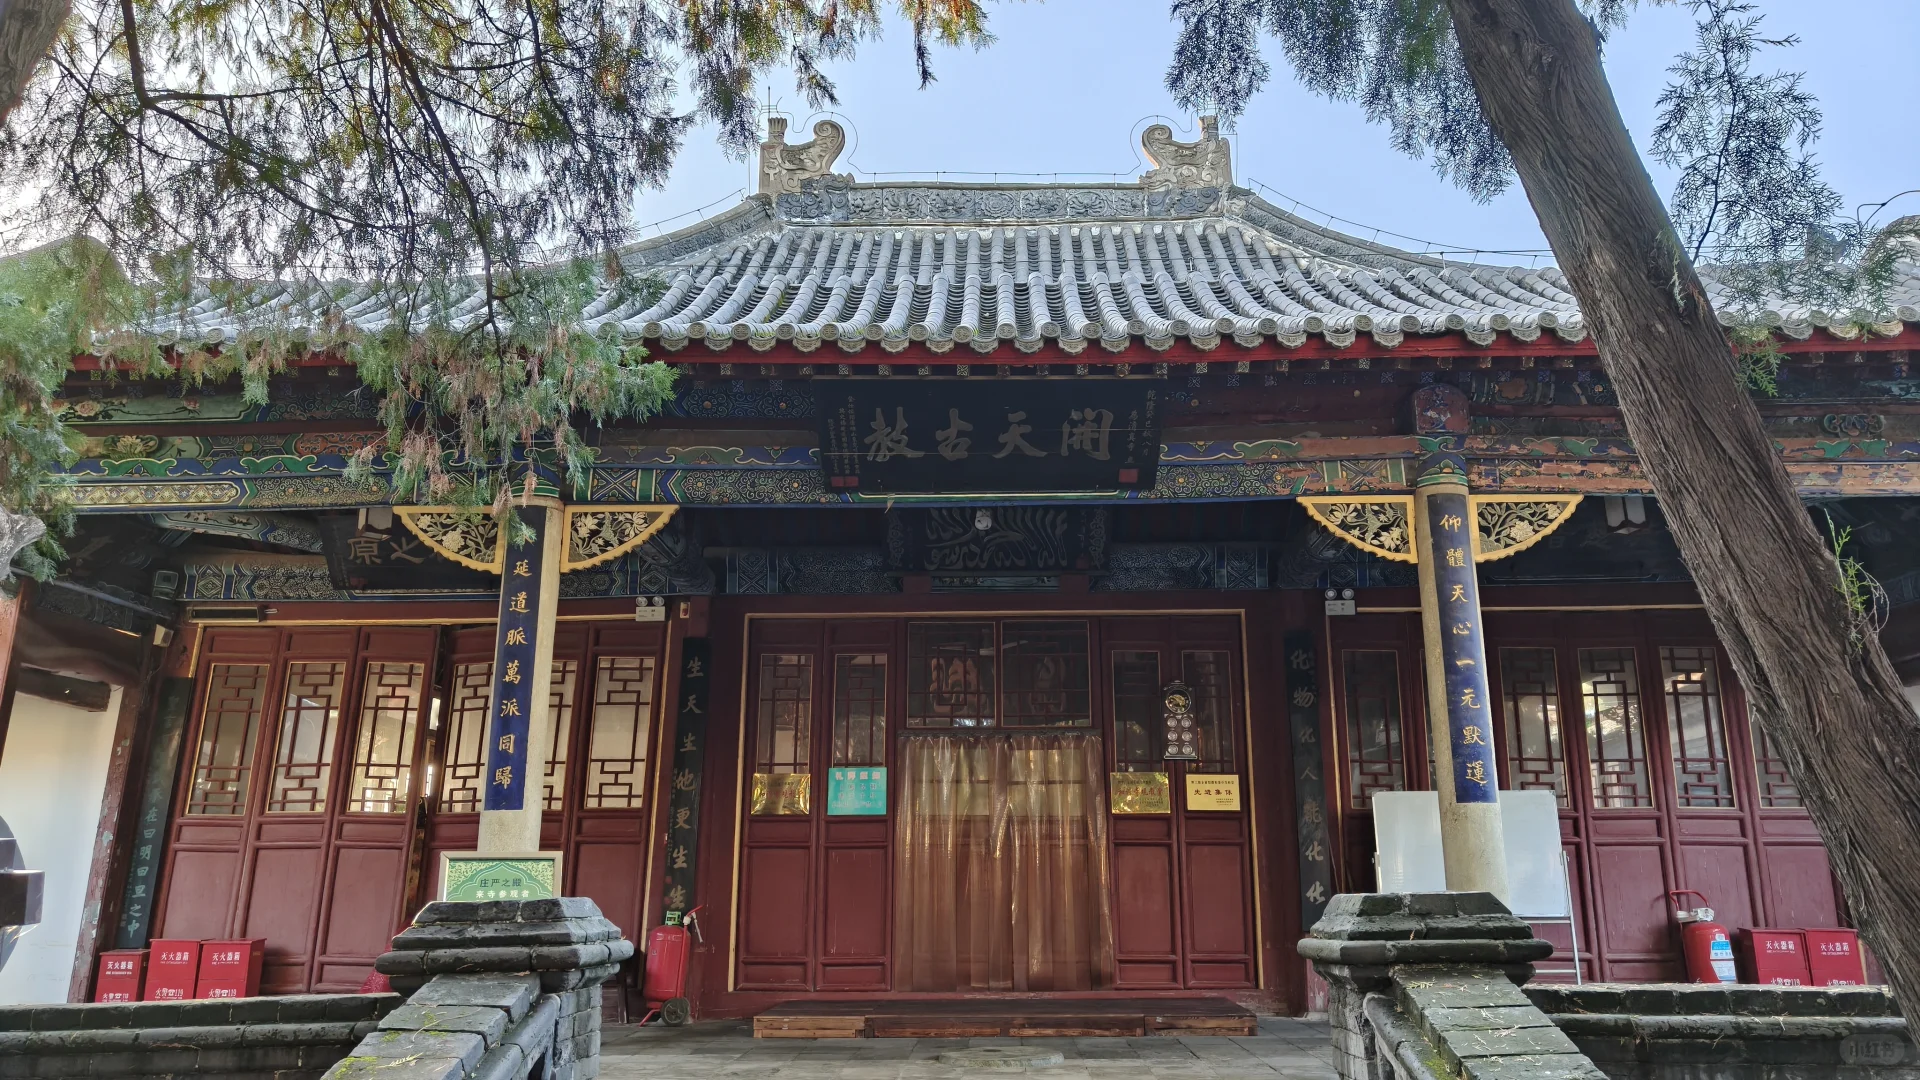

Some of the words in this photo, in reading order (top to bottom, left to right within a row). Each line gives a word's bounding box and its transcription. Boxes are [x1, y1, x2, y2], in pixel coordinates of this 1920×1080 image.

[1439, 513, 1489, 785] 仰體天心一元默運
[493, 522, 533, 789] 延道脈萬派同歸
[479, 878, 522, 887] 庄严之殿
[475, 889, 530, 898] 来寺参观者
[1765, 940, 1795, 951] 灭火器箱
[1820, 943, 1849, 952] 灭火器箱
[160, 952, 190, 961] 灭火器箱
[212, 952, 240, 961] 灭火器箱
[107, 961, 133, 970] 灭火器箱
